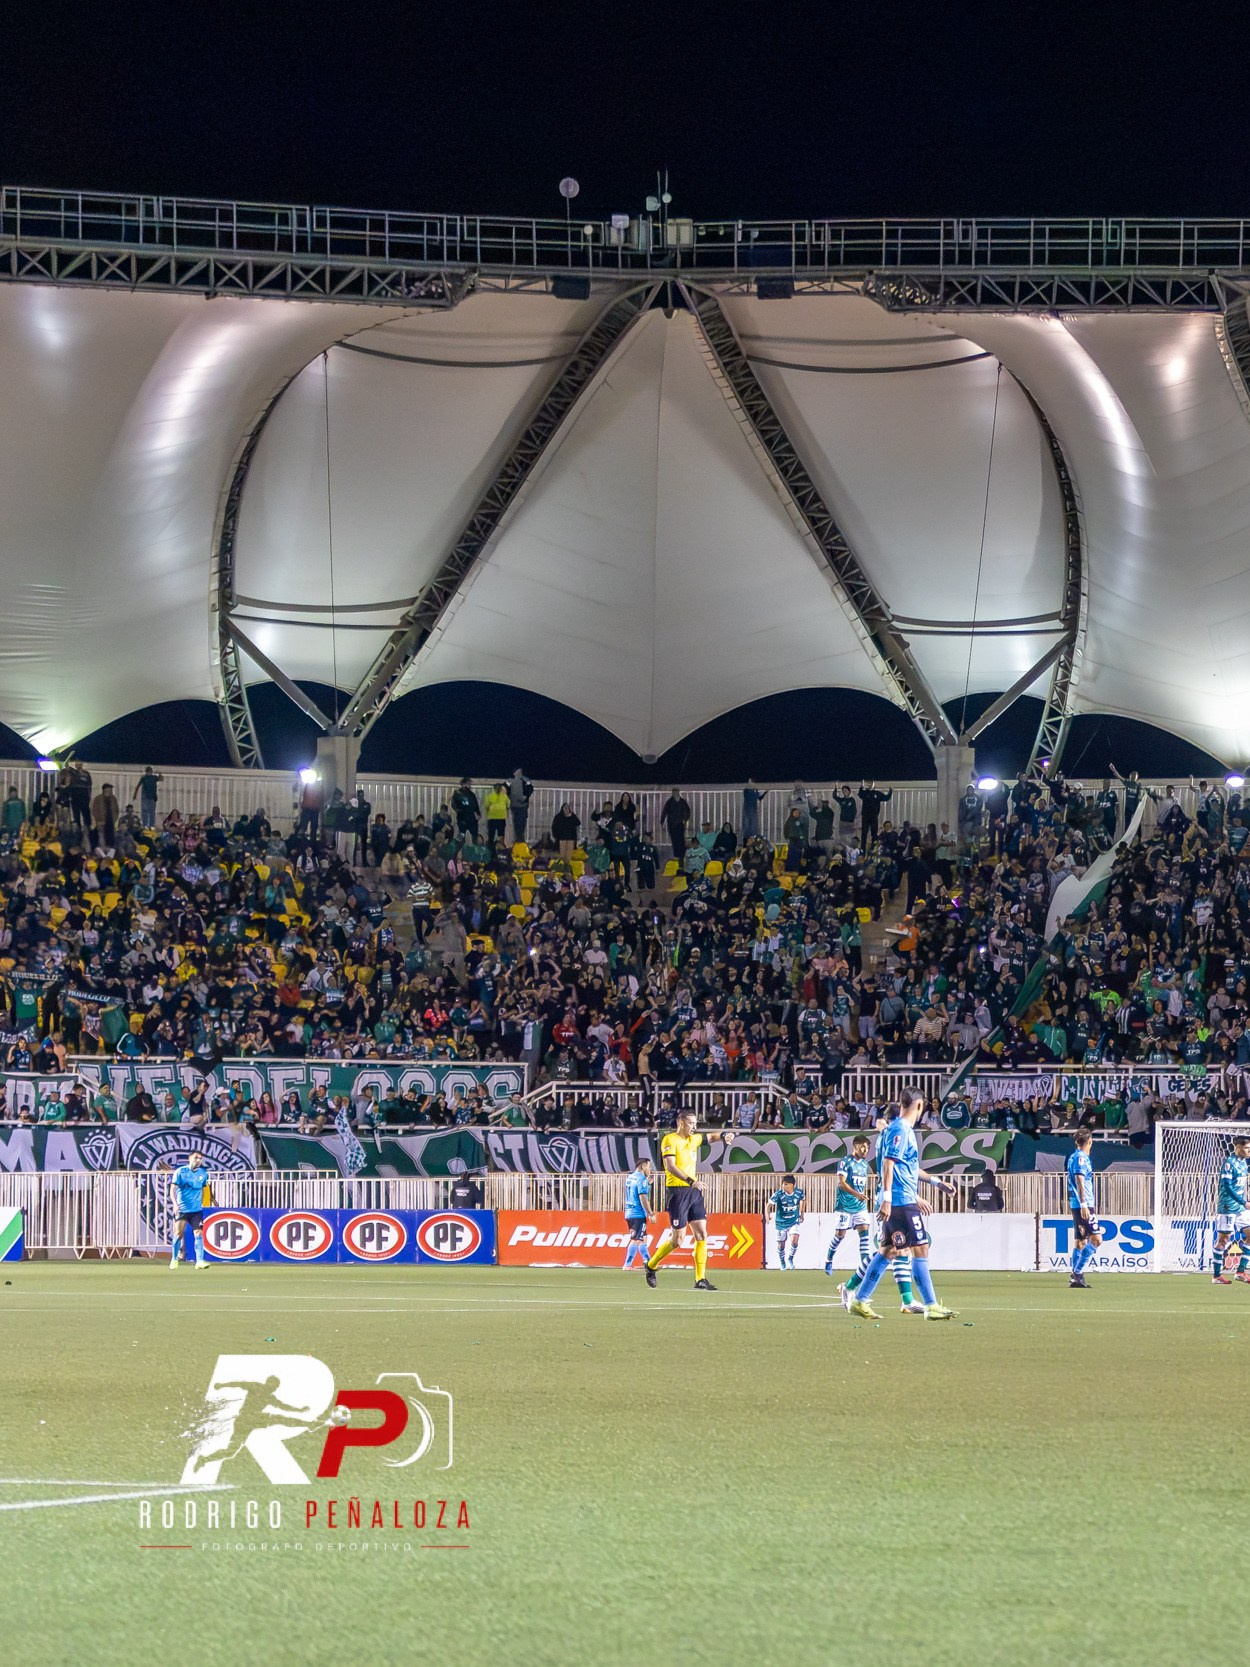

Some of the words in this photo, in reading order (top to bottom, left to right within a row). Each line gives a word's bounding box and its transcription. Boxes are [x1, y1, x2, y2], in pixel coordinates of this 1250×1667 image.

[214, 1220, 244, 1250] PF
[286, 1221, 317, 1250] PF
[360, 1222, 390, 1251] PF
[433, 1222, 464, 1252] PF
[912, 1216, 922, 1231] 5
[1043, 1219, 1154, 1254] TPS
[1050, 1255, 1149, 1268] VALARAÍSO
